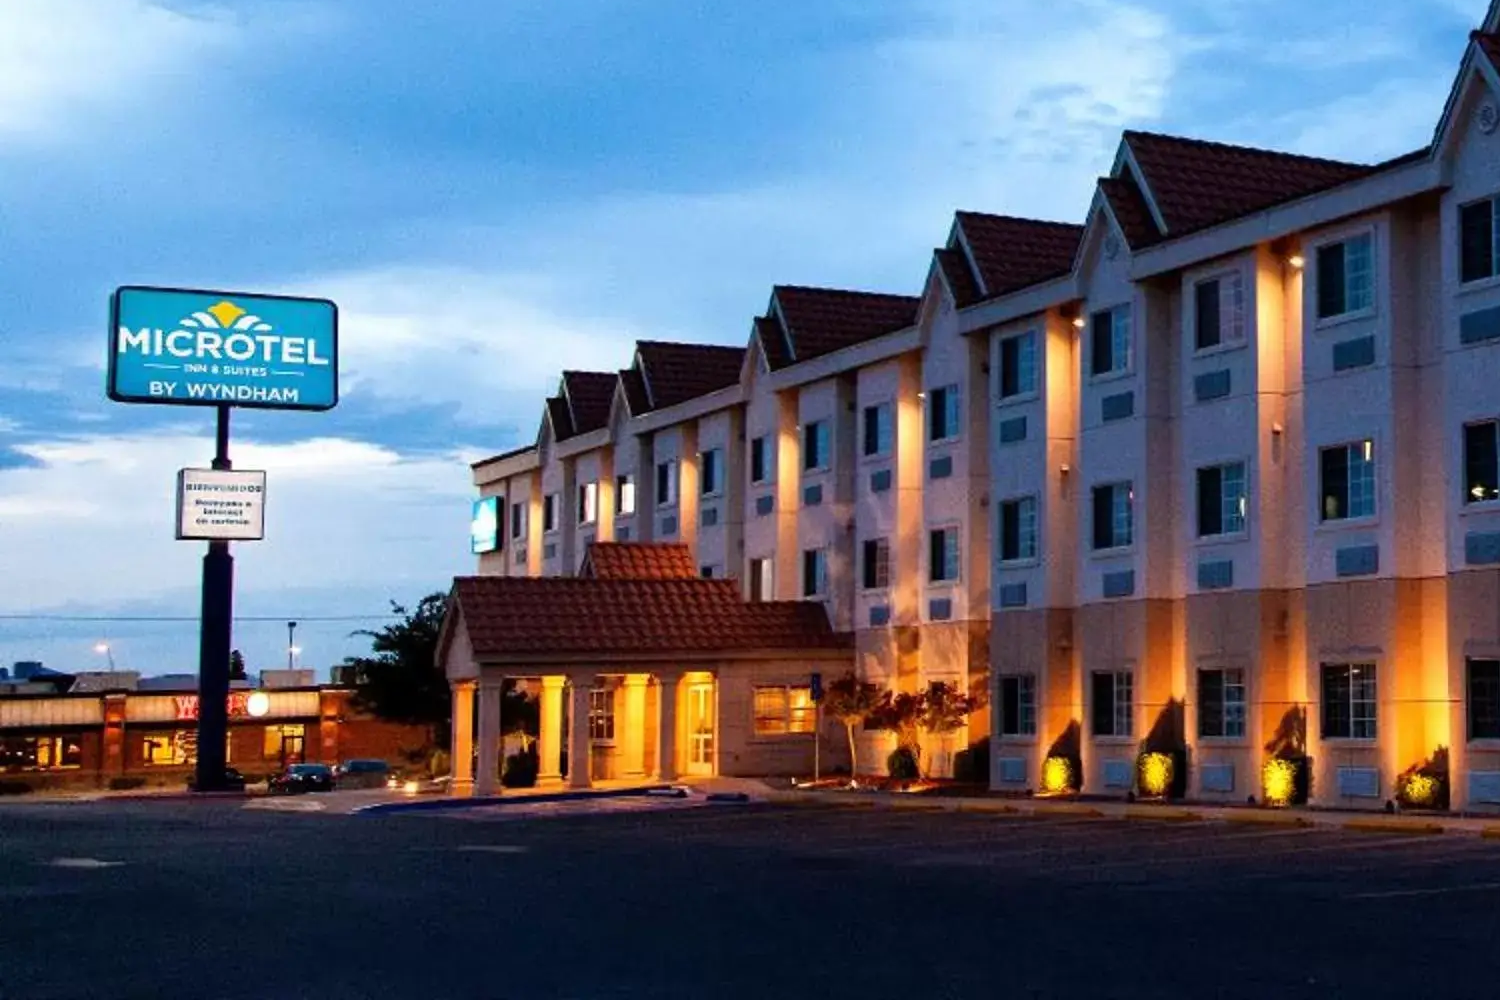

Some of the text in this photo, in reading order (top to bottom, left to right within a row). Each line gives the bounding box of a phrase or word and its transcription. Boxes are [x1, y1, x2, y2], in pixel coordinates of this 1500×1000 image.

[118, 327, 329, 365] MICROTEL
[223, 365, 267, 377] SUITES
[150, 381, 299, 402] BY WYNDHAM
